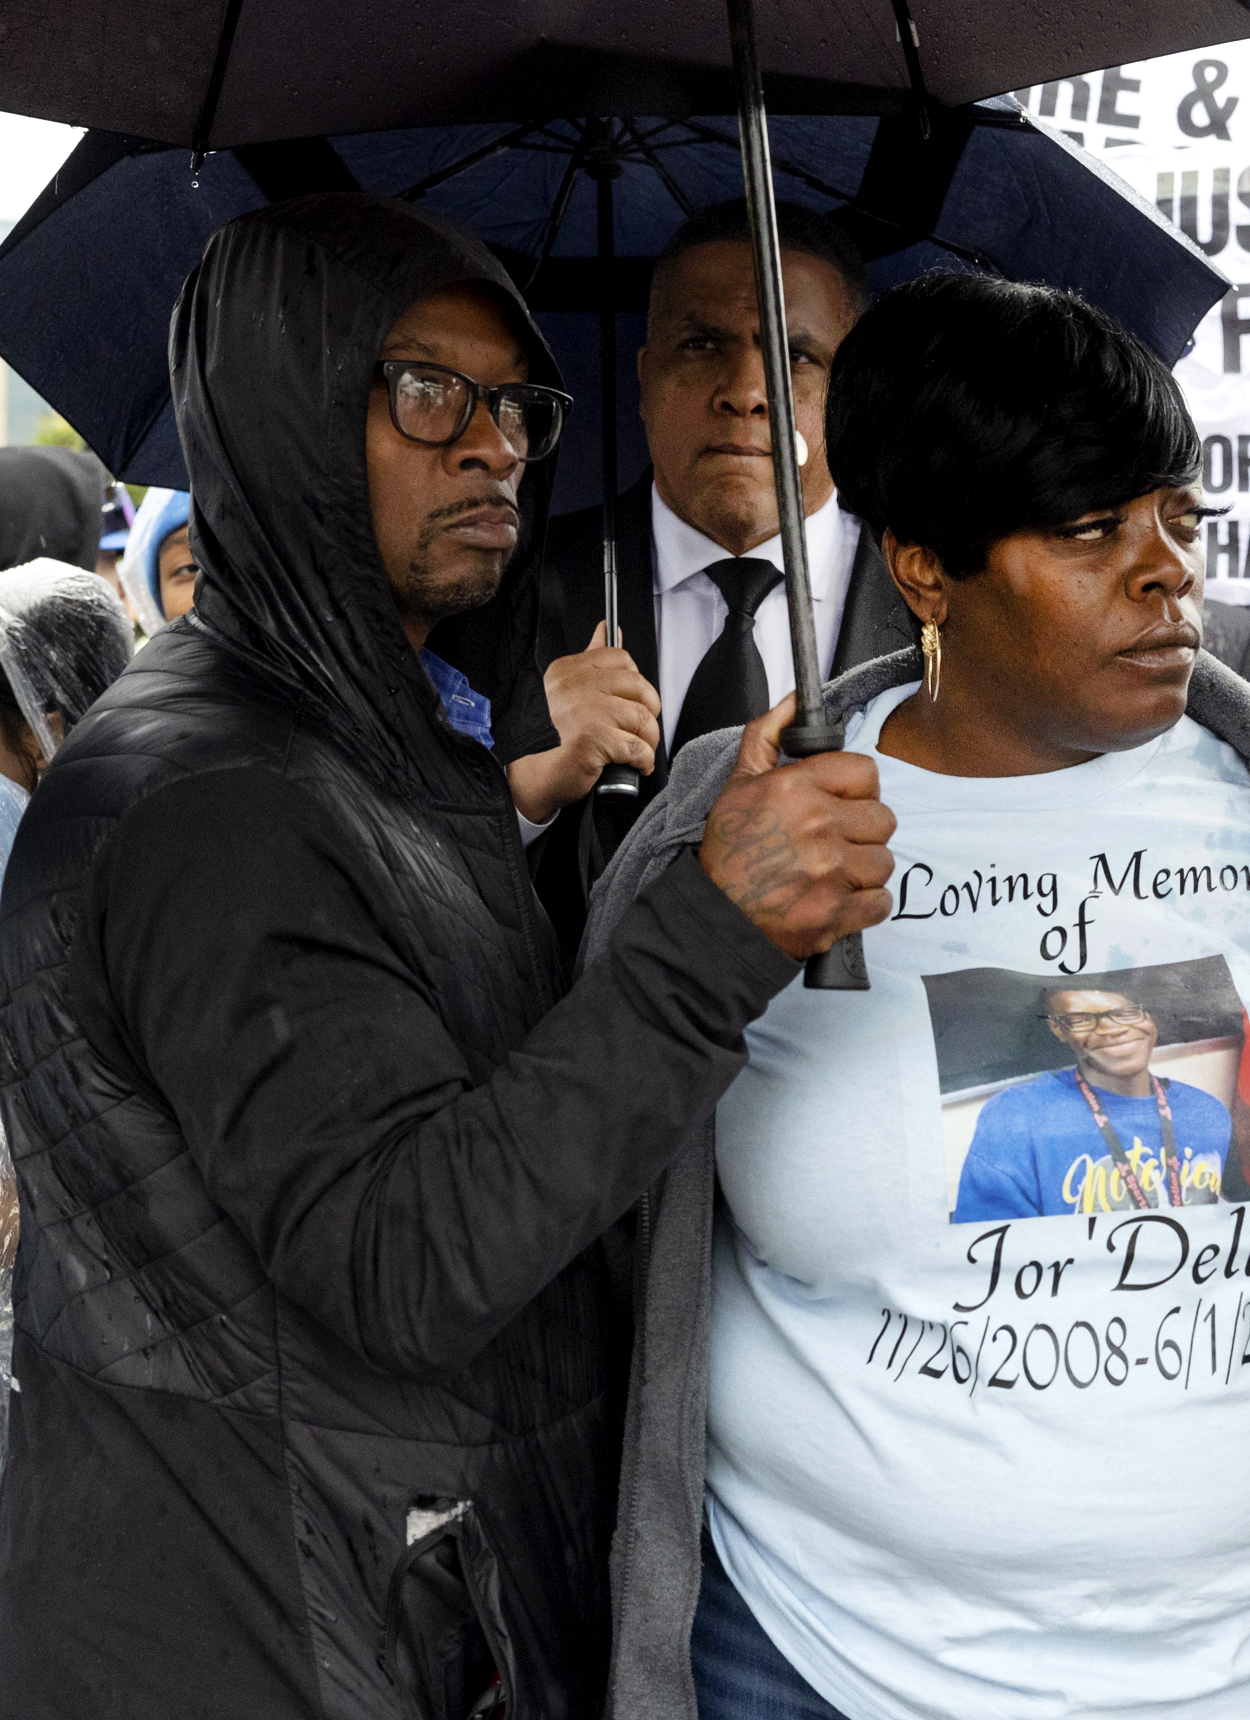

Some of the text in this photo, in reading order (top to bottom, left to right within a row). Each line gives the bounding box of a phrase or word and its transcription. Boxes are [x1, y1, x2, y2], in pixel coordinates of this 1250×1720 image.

[1176, 58, 1239, 142] &
[891, 862, 1058, 921] Loving
[1039, 895, 1101, 975] of
